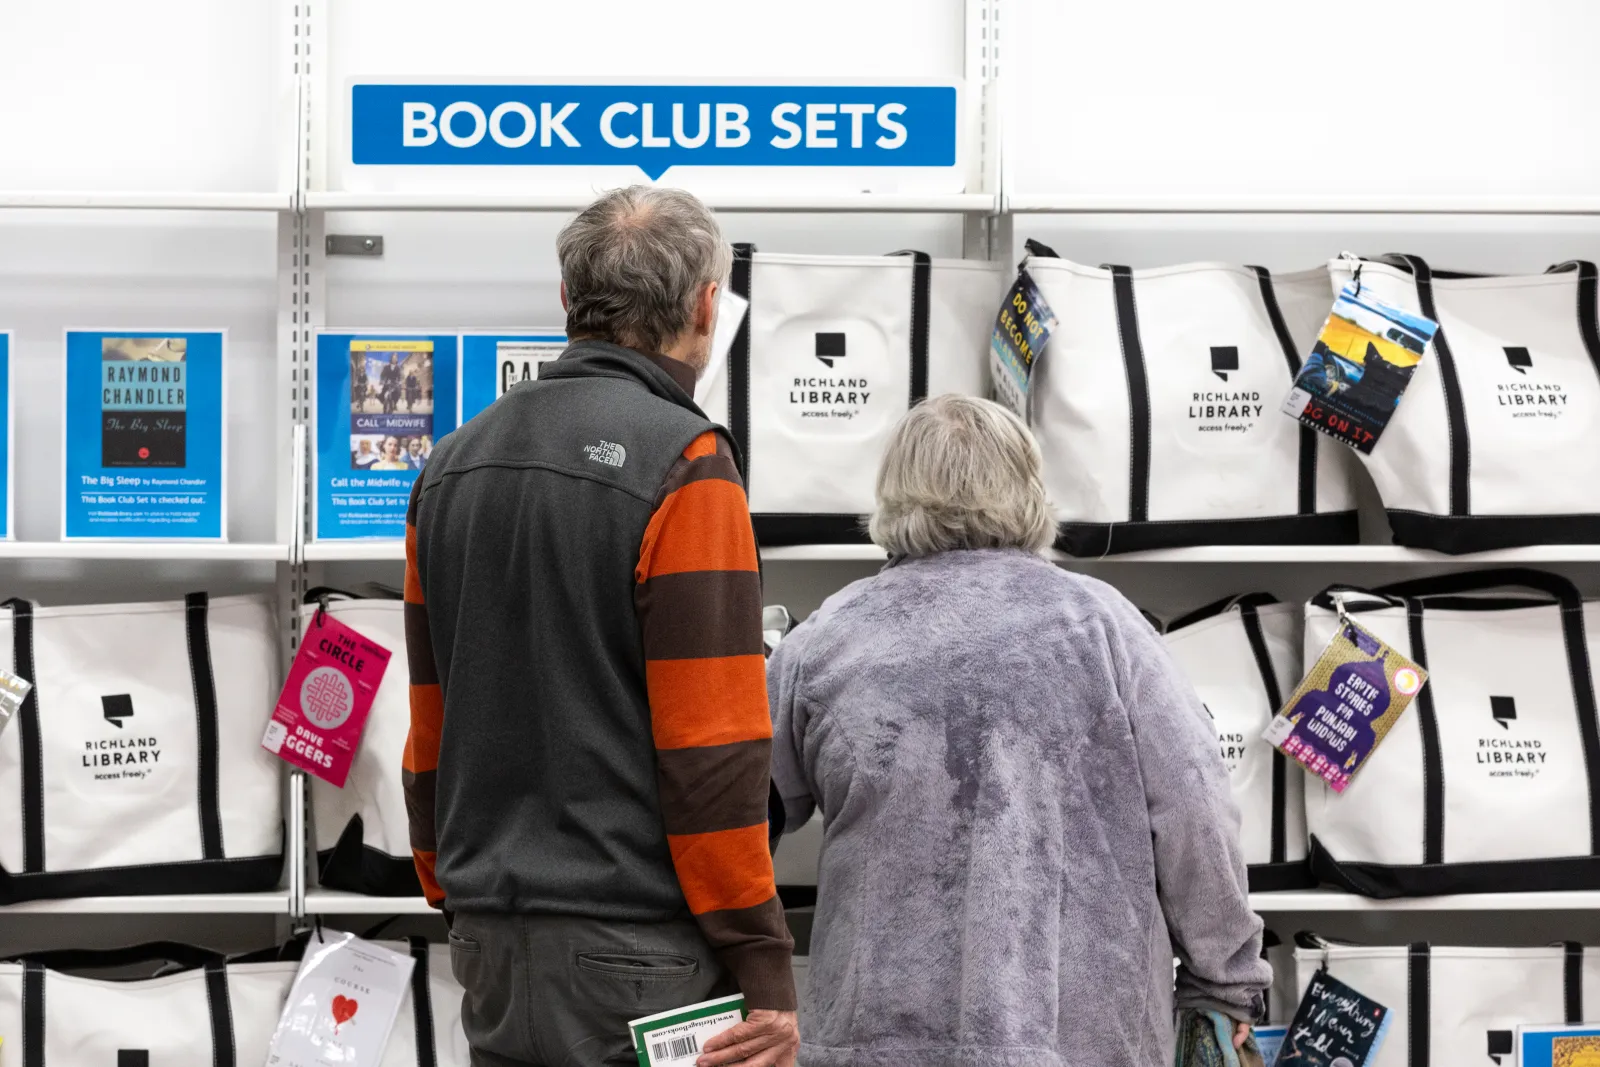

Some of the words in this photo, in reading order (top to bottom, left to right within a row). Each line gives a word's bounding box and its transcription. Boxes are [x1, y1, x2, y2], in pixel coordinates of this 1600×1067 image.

[402, 101, 582, 149] BOOK
[600, 101, 751, 149] CLUB
[770, 102, 908, 150] SETS
[1012, 292, 1027, 314] DO
[1023, 311, 1044, 340] NOT
[1000, 309, 1033, 365] BECOME
[107, 366, 181, 382] RAYMOND
[794, 378, 868, 388] RICHLAND
[1497, 383, 1561, 391] RICHLAND
[103, 388, 184, 404] CHANDLER
[790, 391, 871, 404] LIBRARY
[1193, 392, 1260, 401] RICHLAND
[1498, 394, 1567, 405] LIBRARY
[801, 410, 829, 418] access
[1189, 405, 1263, 418] LIBRARY
[106, 418, 125, 431] The
[130, 418, 148, 433] Big
[153, 418, 183, 433] Sleep
[356, 418, 379, 428] CALL
[386, 418, 426, 428] MIDWIFE
[1301, 417, 1330, 435] PENCER
[1303, 402, 1323, 420] OG
[1328, 415, 1348, 433] ON
[1352, 426, 1374, 444] IT
[584, 444, 613, 457] NORTH
[600, 440, 616, 451] THE
[589, 453, 610, 464] FACE
[81, 476, 97, 485] The
[100, 476, 114, 487] Big
[116, 476, 140, 487] Sleep
[143, 478, 150, 487] by
[152, 478, 178, 487] Raymond
[331, 478, 348, 487] Call
[350, 478, 365, 487] the
[367, 478, 401, 487] Midwife
[81, 496, 96, 504] This
[98, 496, 116, 504] Book
[118, 496, 135, 504] Club
[137, 496, 149, 504] Set
[151, 496, 157, 504] is
[158, 496, 189, 504] checked
[191, 496, 206, 504] out.
[332, 497, 347, 506] This
[348, 497, 366, 506] Book
[368, 497, 385, 506] Club
[386, 497, 397, 506] Set
[338, 634, 357, 649] THE
[319, 639, 365, 673] CIRCLE
[1346, 673, 1380, 702] EROTIC
[1334, 683, 1373, 717] STORIES
[1336, 702, 1354, 721] FOR
[1315, 705, 1358, 742] PUNJABI
[295, 725, 324, 747] DAVE
[1307, 718, 1348, 752] WIDOWS
[85, 738, 157, 750] RICHLAND
[1478, 739, 1542, 748] RICHLAND
[82, 750, 161, 767] LIBRARY
[1477, 752, 1546, 763] LIBRARY
[94, 772, 120, 780] access
[334, 977, 371, 995] COURSE
[1311, 982, 1376, 1038] Everything
[651, 1014, 735, 1038] www.HeritageBooks.com
[1314, 1009, 1355, 1044] Never
